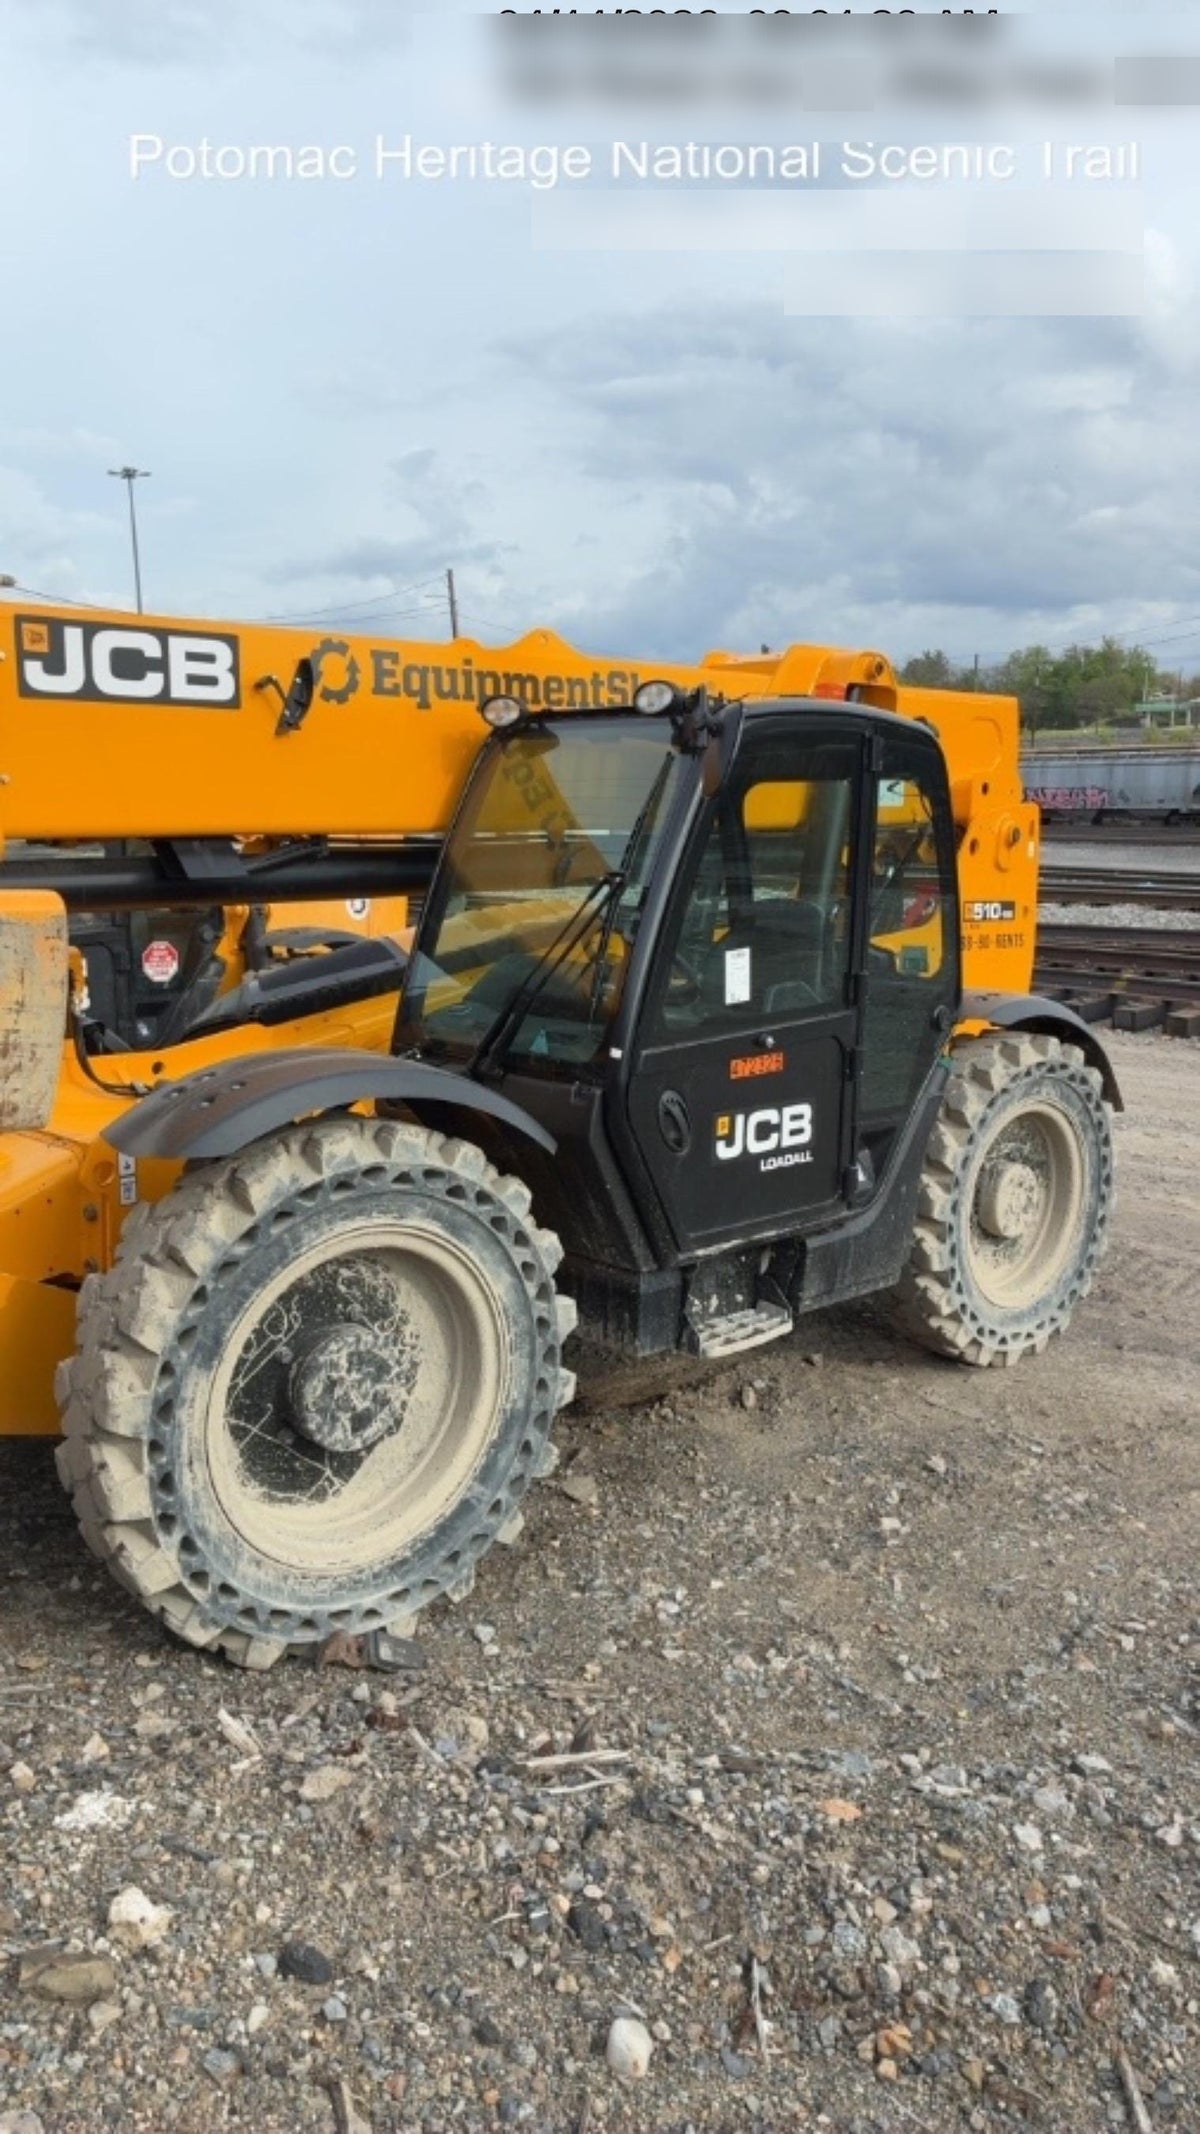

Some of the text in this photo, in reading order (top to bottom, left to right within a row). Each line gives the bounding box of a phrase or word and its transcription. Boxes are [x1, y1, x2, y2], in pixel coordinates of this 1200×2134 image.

[23, 625, 236, 701] JCB
[716, 1103, 812, 1160] JCB
[760, 1149, 814, 1172] LOADALL
